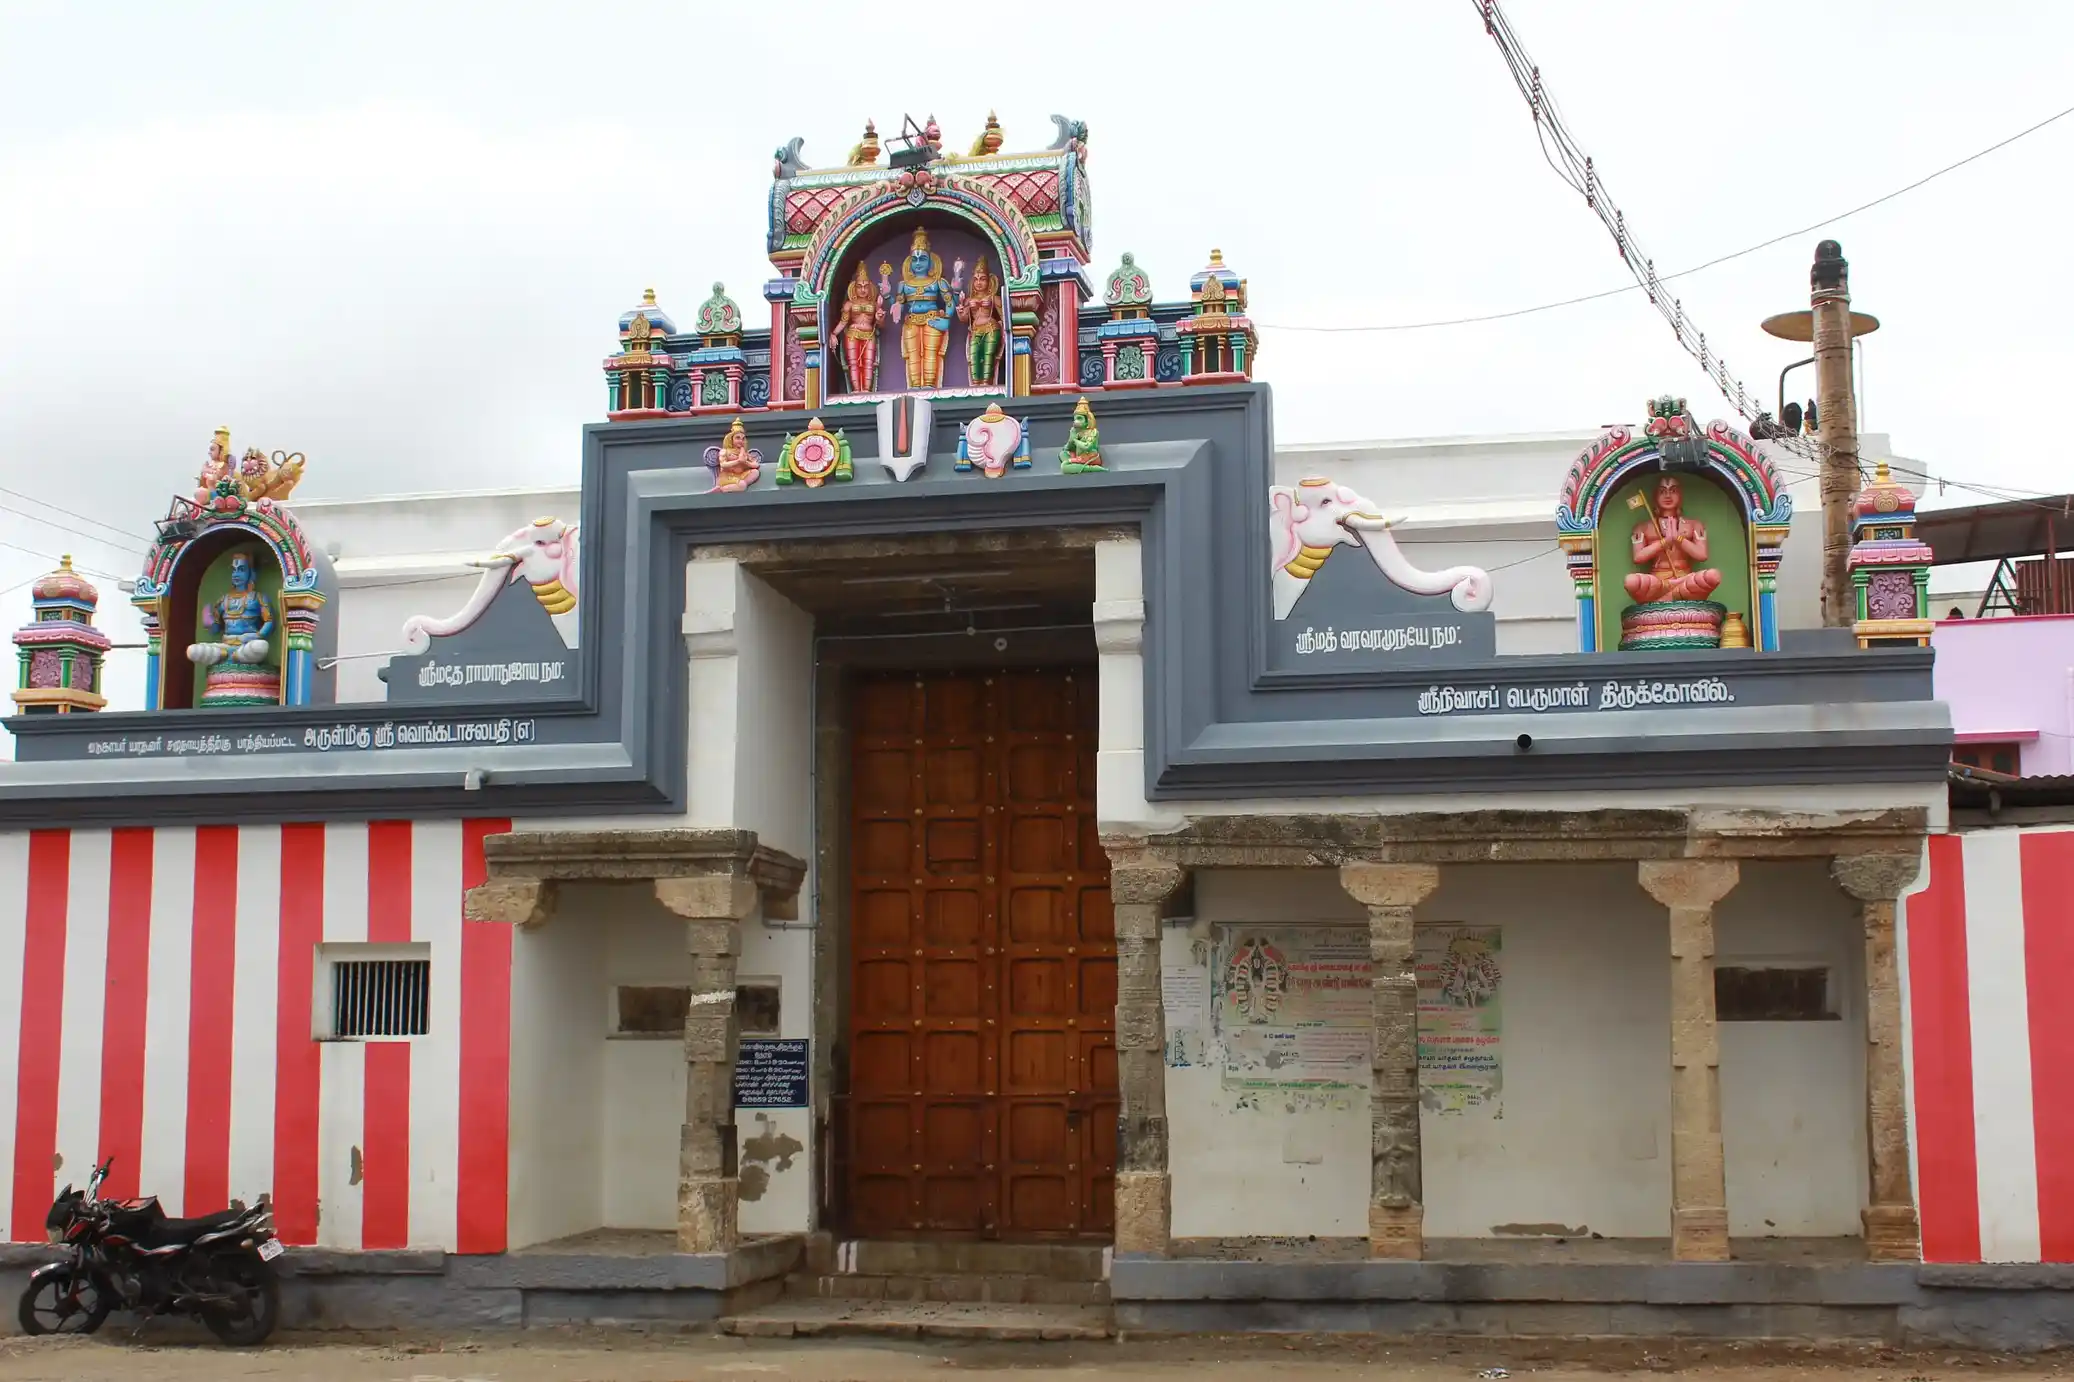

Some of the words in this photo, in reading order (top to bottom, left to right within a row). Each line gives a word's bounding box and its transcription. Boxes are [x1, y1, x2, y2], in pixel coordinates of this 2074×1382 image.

[1507, 681, 1590, 712] பெருமாள்
[303, 722, 371, 751] அருள்மிகு
[374, 720, 395, 748] ஸ்ரீ
[397, 718, 511, 745] வெங்கடாசலபதி
